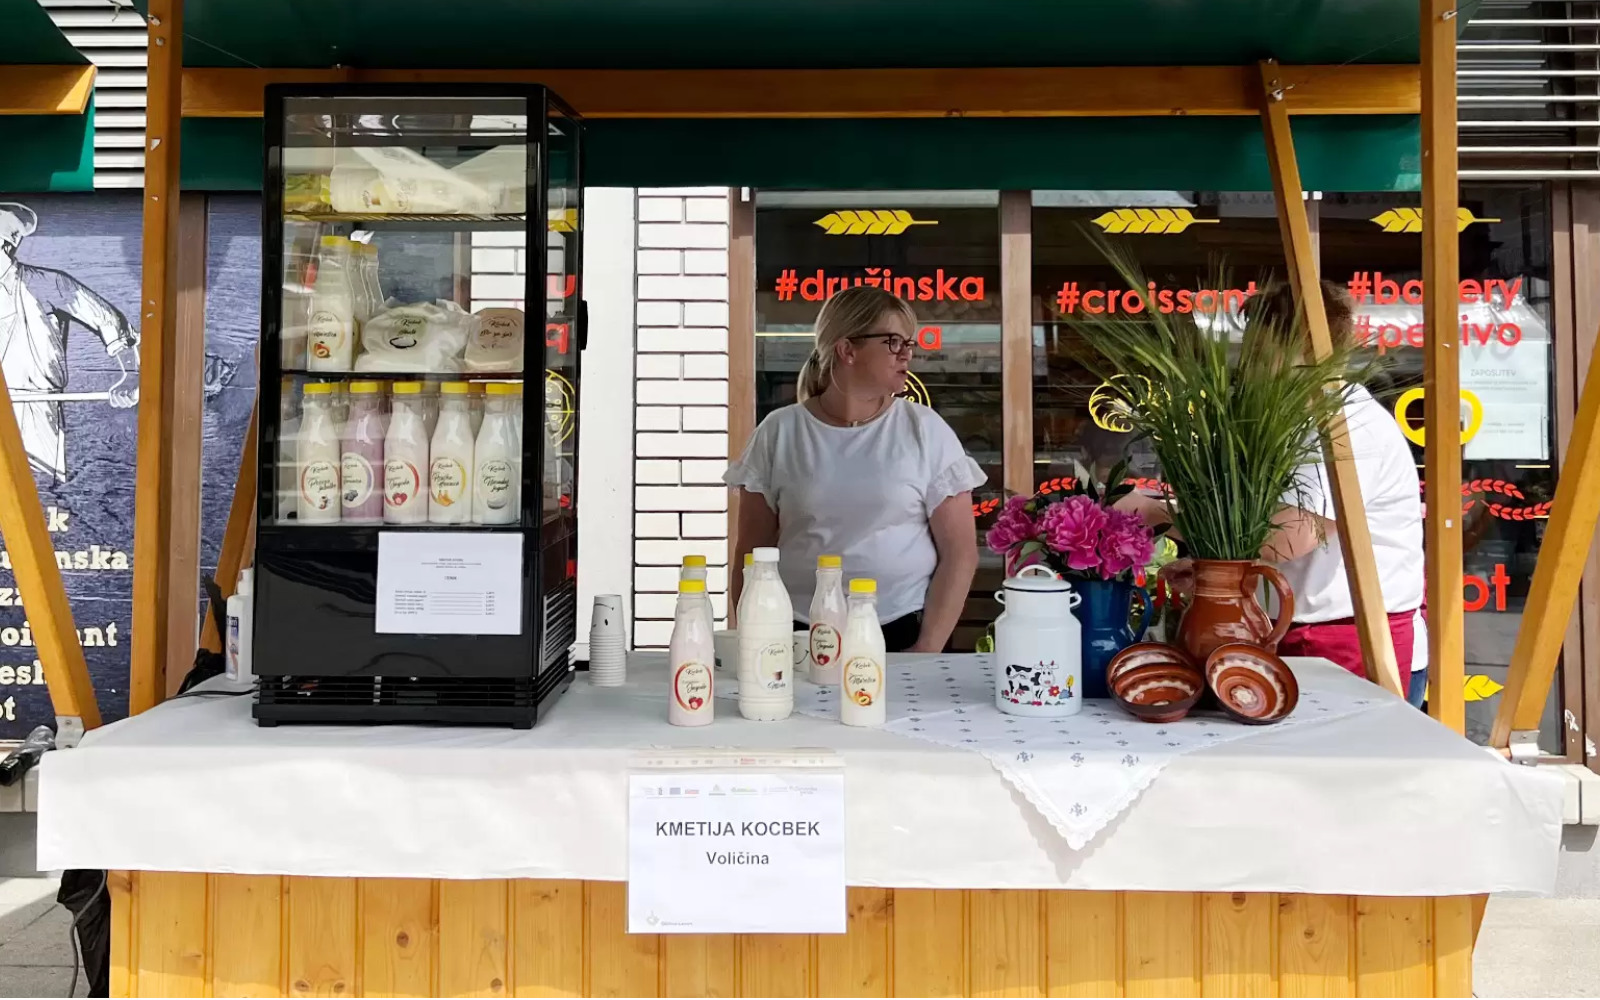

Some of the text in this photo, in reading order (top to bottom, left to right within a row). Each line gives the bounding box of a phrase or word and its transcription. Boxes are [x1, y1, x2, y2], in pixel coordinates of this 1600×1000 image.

[1348, 272, 1523, 311] #baery
[1354, 314, 1523, 356] #peivo
[656, 822, 820, 836] KMETIJA KOCBEK
[706, 851, 770, 865] Voličina
